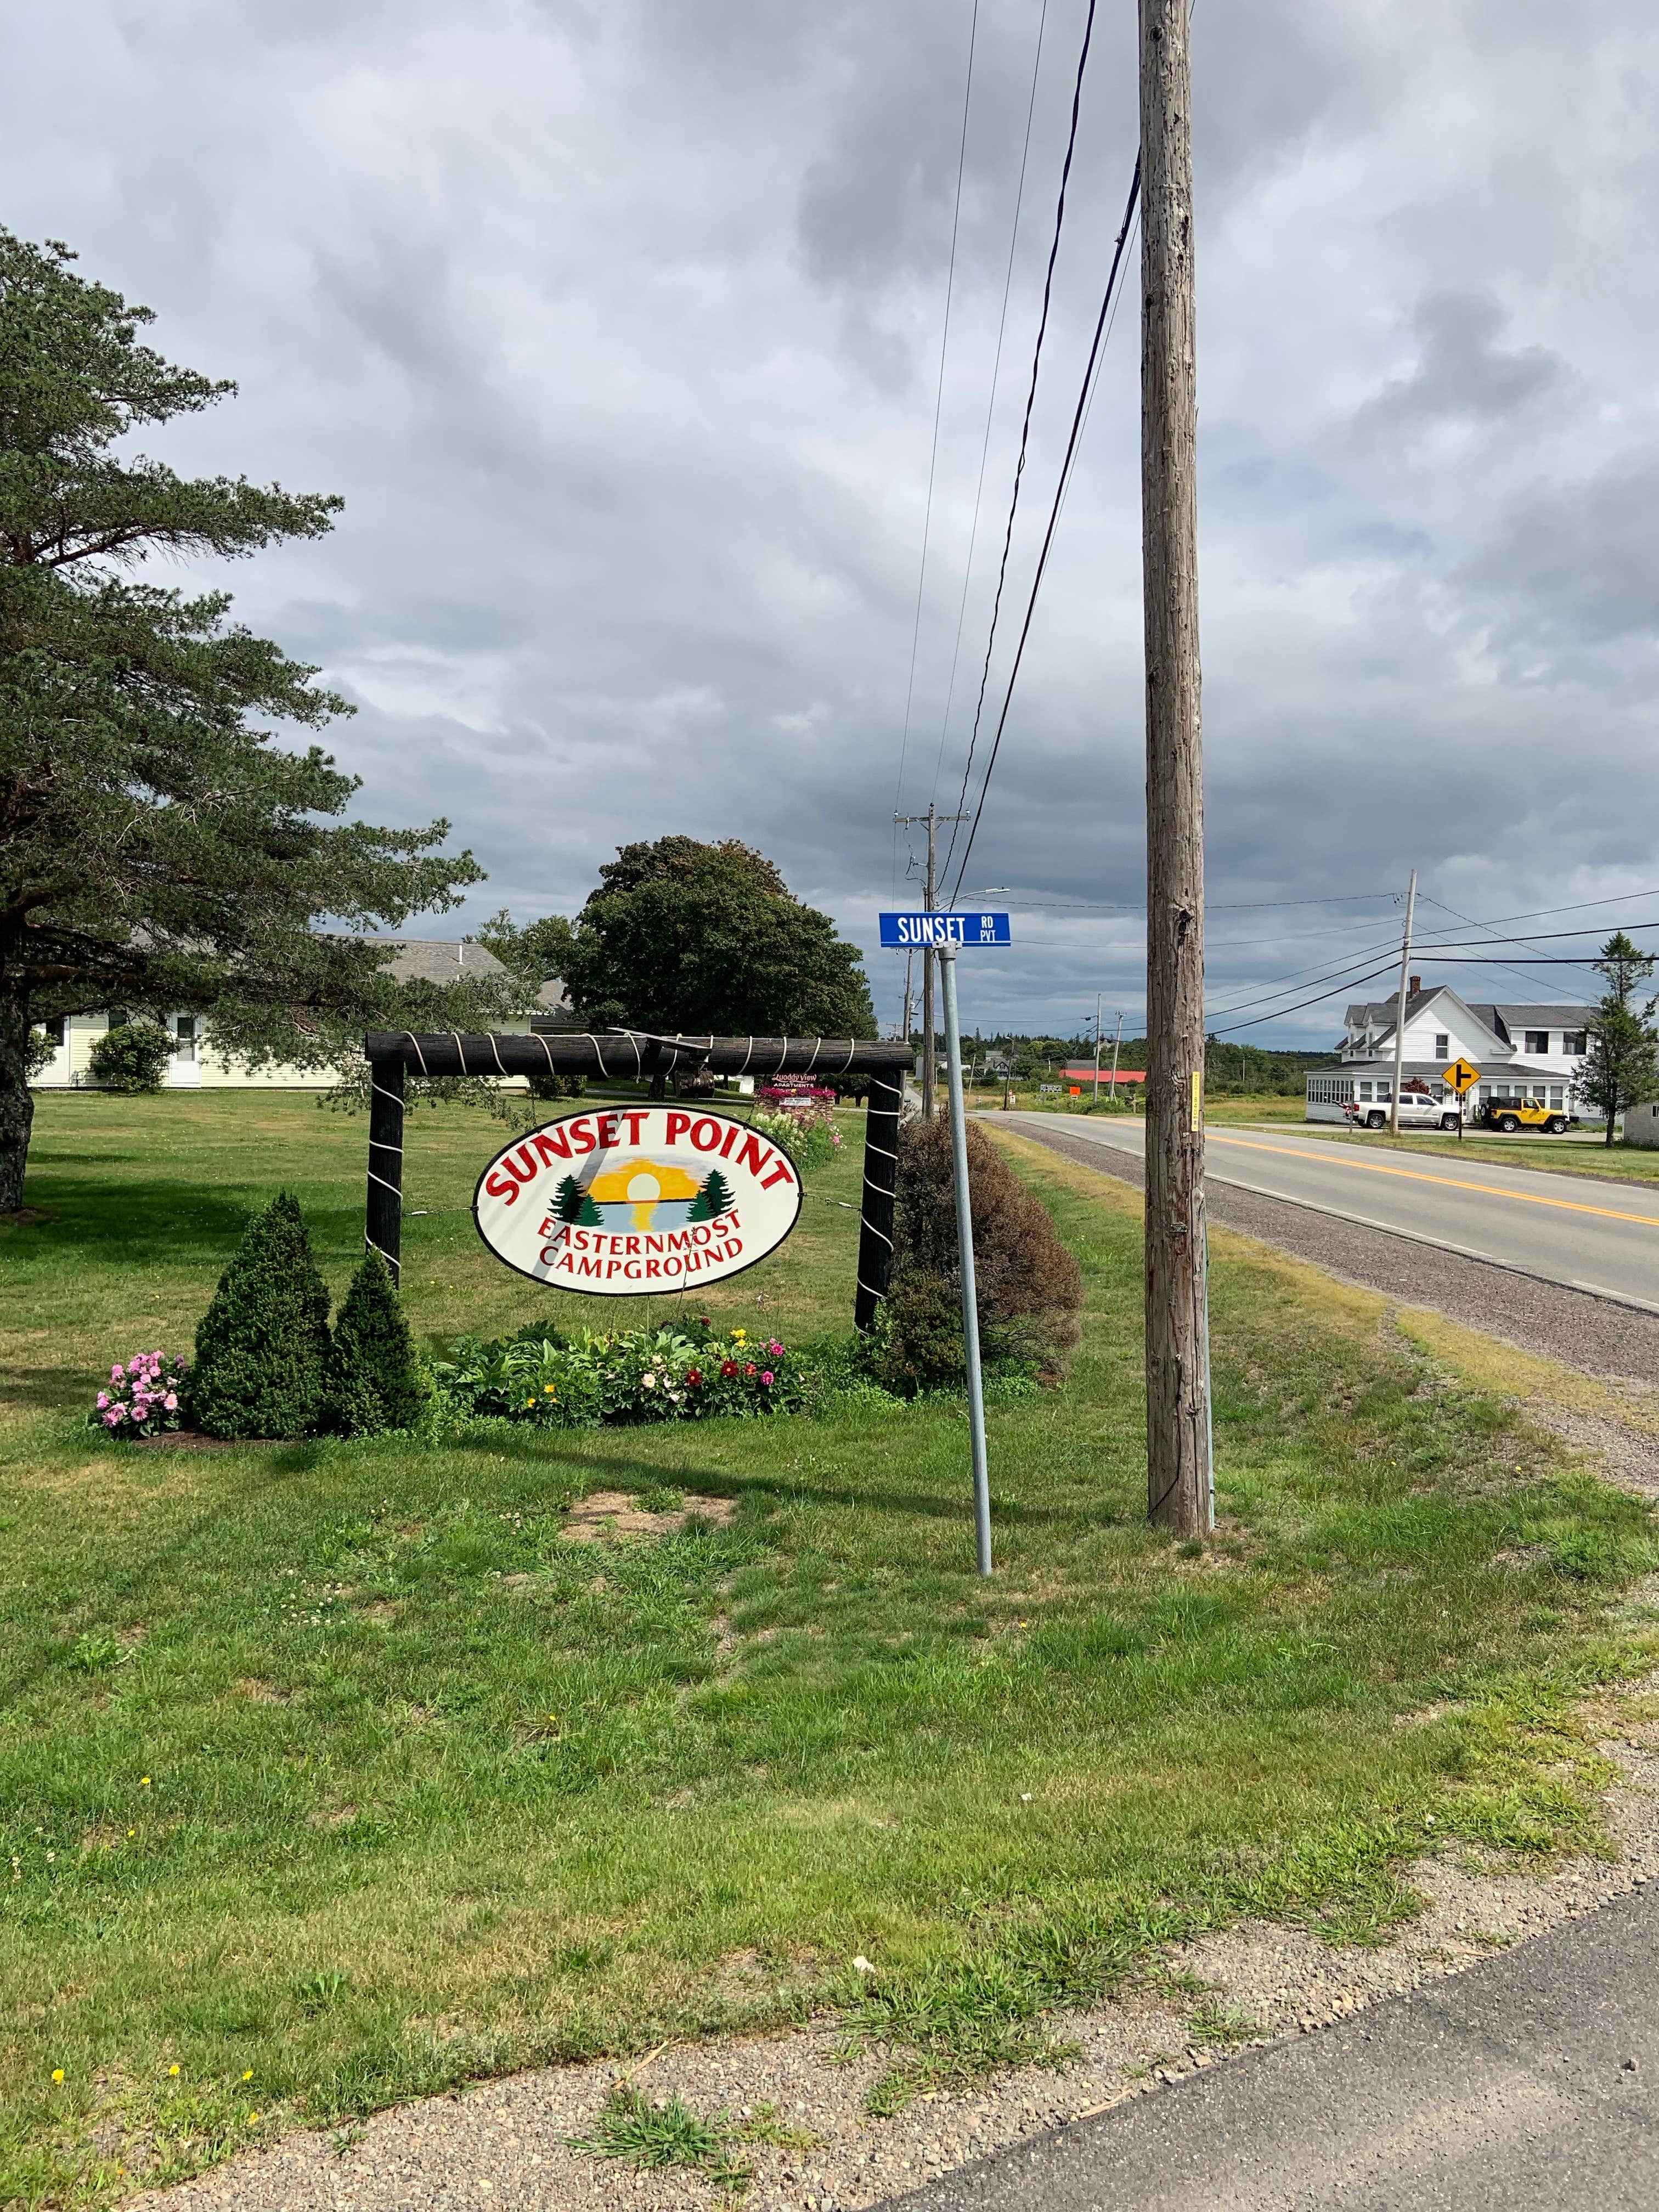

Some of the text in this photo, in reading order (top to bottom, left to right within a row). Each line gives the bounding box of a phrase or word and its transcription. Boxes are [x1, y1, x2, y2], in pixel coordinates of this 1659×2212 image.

[898, 916, 994, 942] SUNSET RD
[980, 929, 996, 942] PVT
[486, 1112, 795, 1206] SUNSET POINT
[538, 1209, 742, 1255] EASTERNMOST
[539, 1238, 743, 1279] CAMPGROUND
